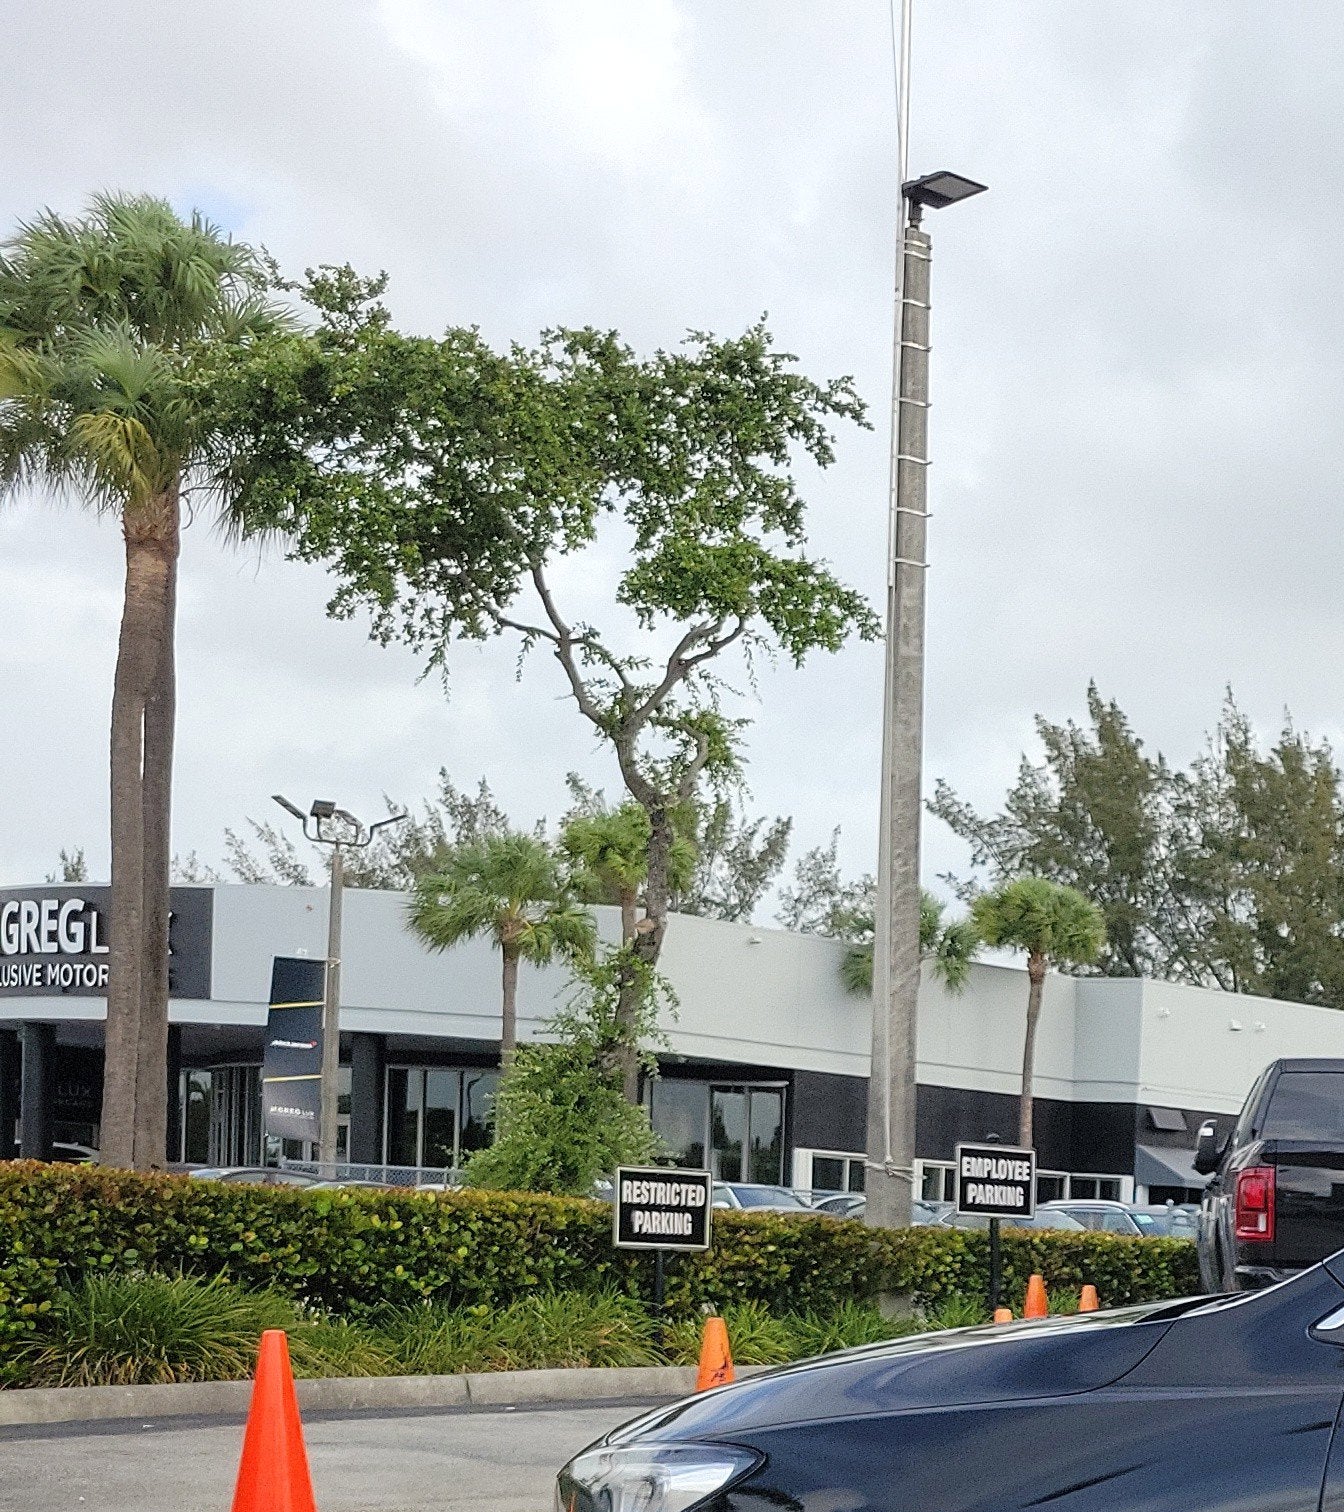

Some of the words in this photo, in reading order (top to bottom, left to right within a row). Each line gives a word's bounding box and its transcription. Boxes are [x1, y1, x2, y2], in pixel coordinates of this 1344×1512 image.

[1, 898, 85, 955] GREG
[47, 963, 109, 988] MOTOR
[962, 1156, 1030, 1181] EMPLOYEE
[622, 1180, 705, 1207] RESTRICTED
[966, 1182, 1024, 1207] PARKING
[633, 1210, 692, 1235] PARKING
